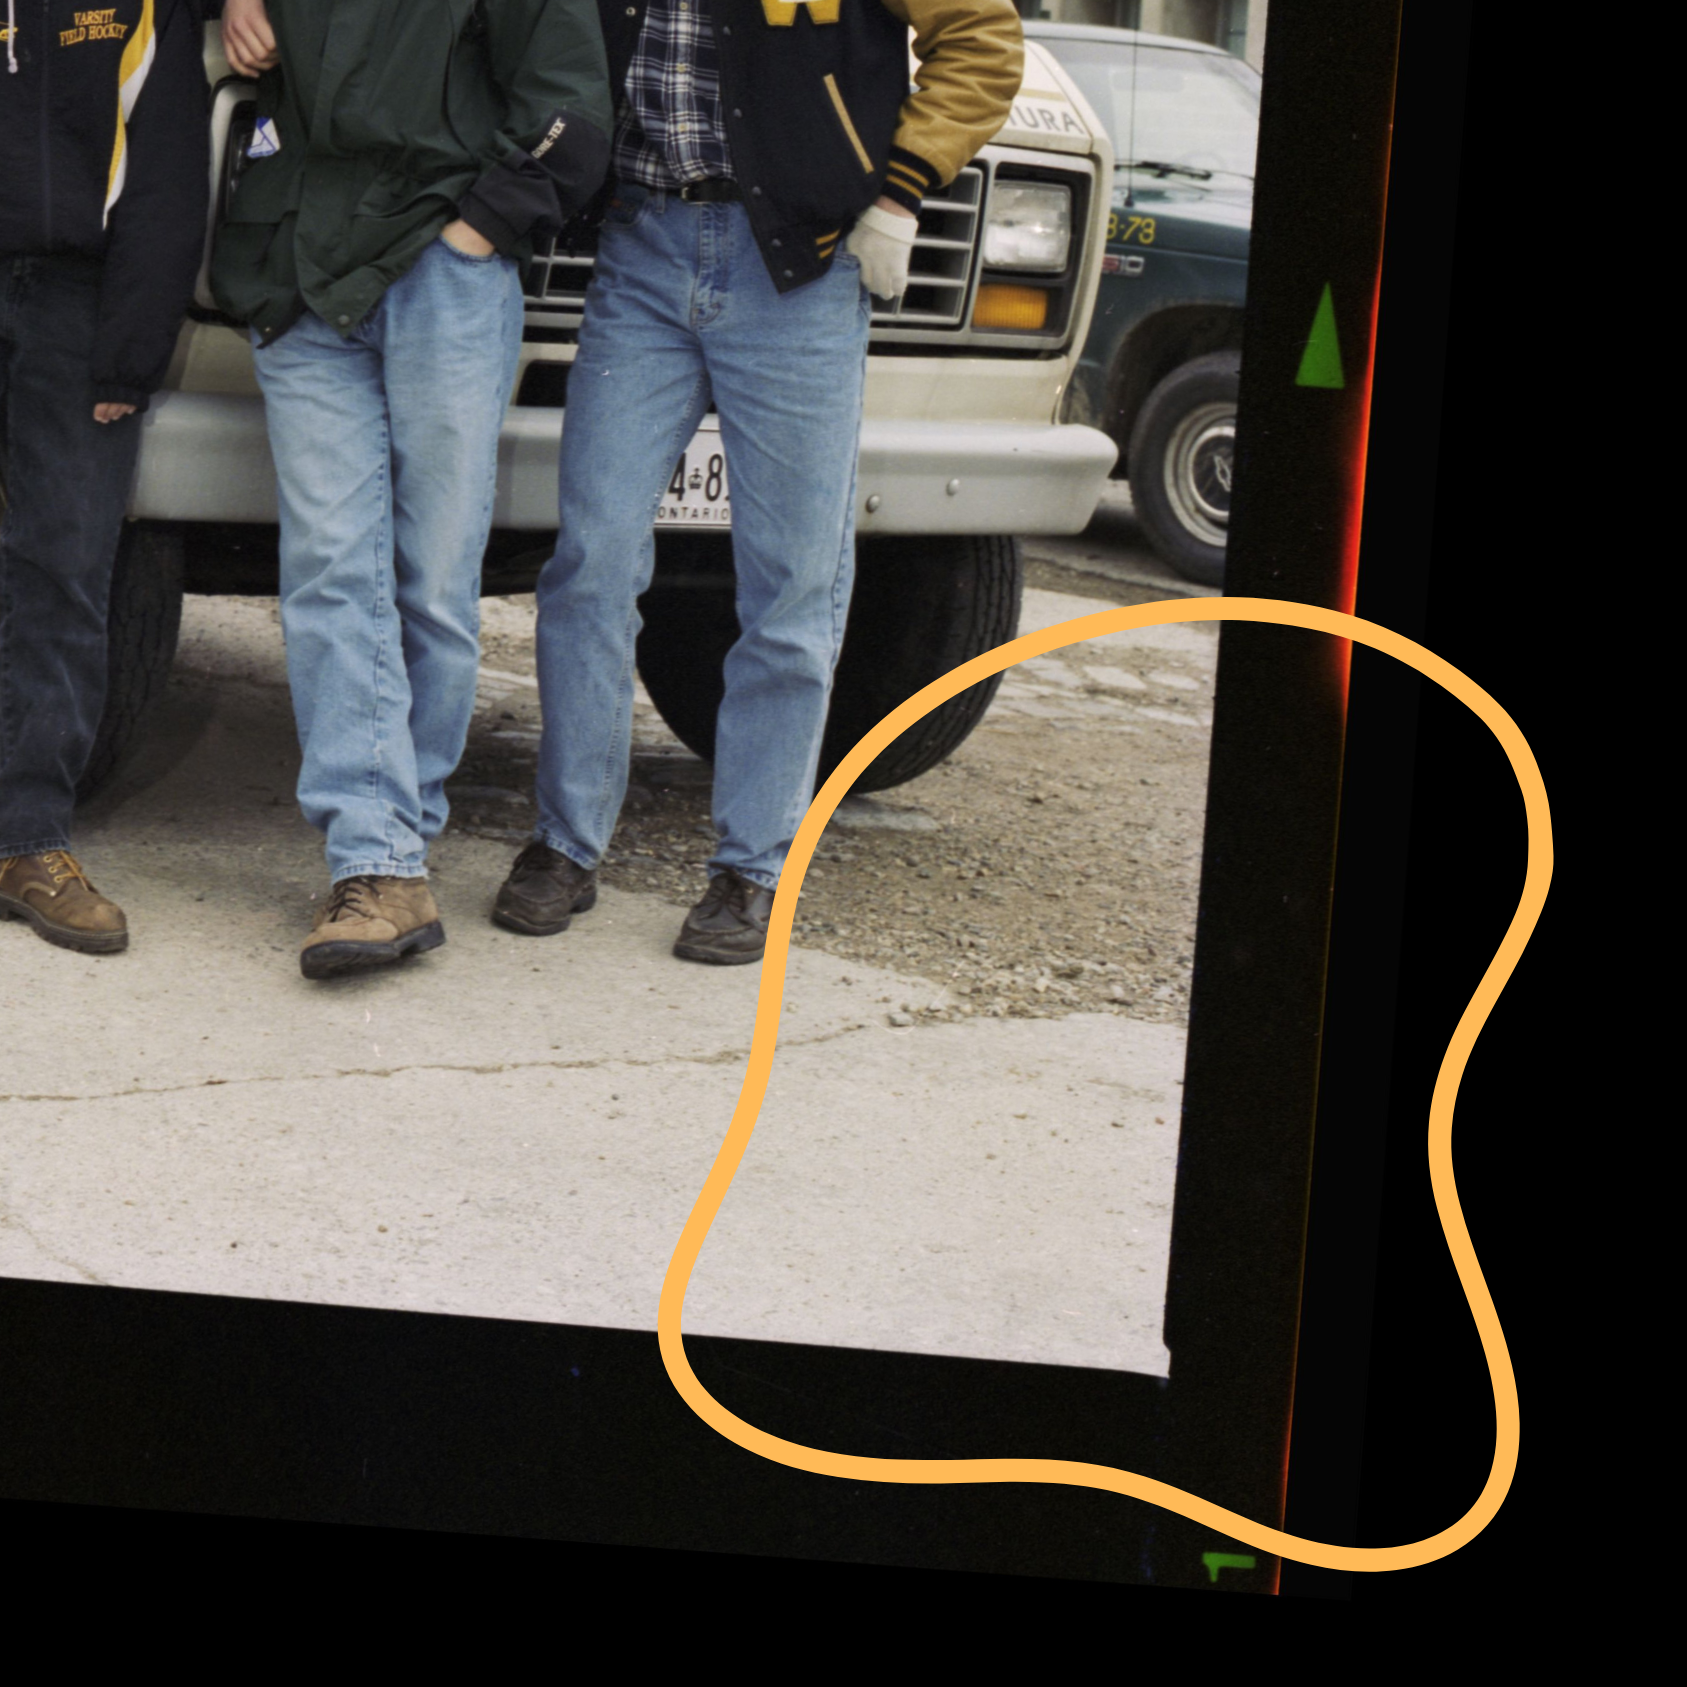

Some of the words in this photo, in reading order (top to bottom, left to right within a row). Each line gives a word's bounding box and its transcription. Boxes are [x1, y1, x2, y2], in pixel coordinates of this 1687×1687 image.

[74, 8, 117, 26] VARSITY
[59, 28, 86, 47] FIELD
[88, 23, 128, 40] HOCKEY
[657, 506, 730, 521] ONTARIO
